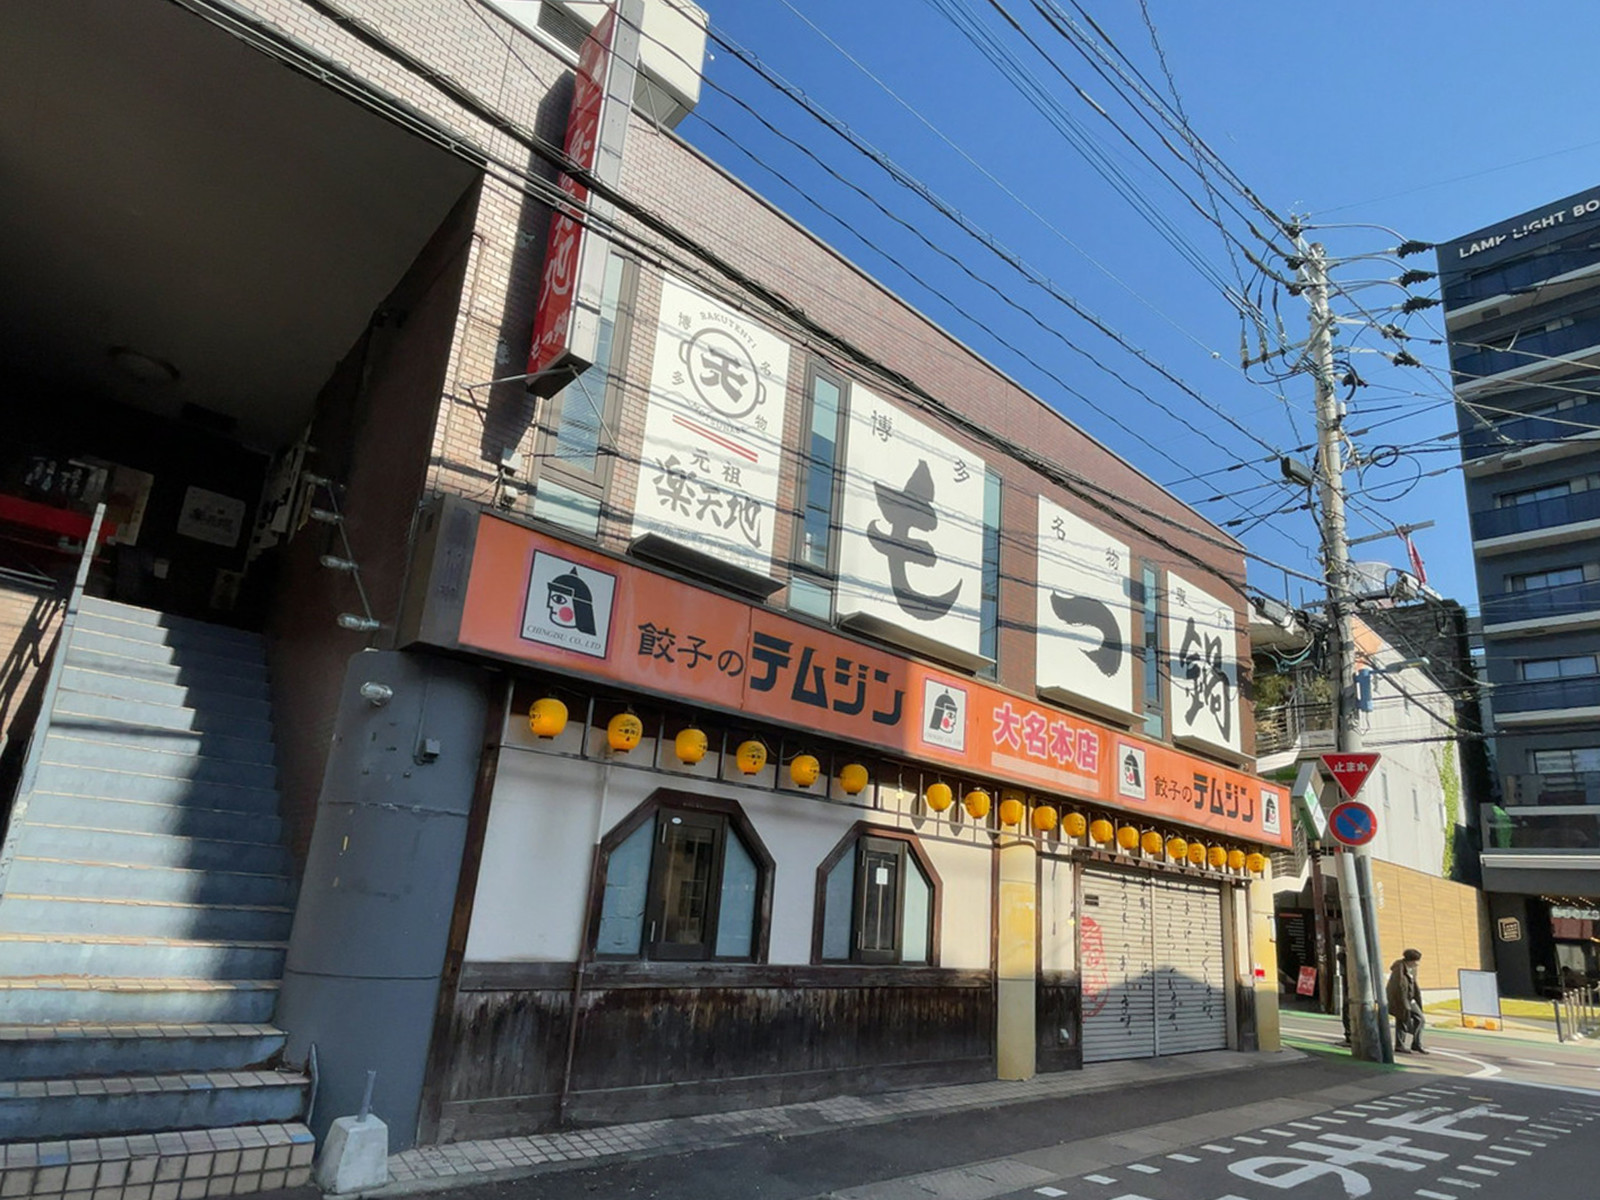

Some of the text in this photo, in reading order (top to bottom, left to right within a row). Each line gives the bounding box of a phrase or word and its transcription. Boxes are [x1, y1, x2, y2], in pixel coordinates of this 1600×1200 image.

[689, 446, 742, 488] 元祖
[992, 701, 1099, 774] 大名本店
[1333, 761, 1369, 773] 止まれ
